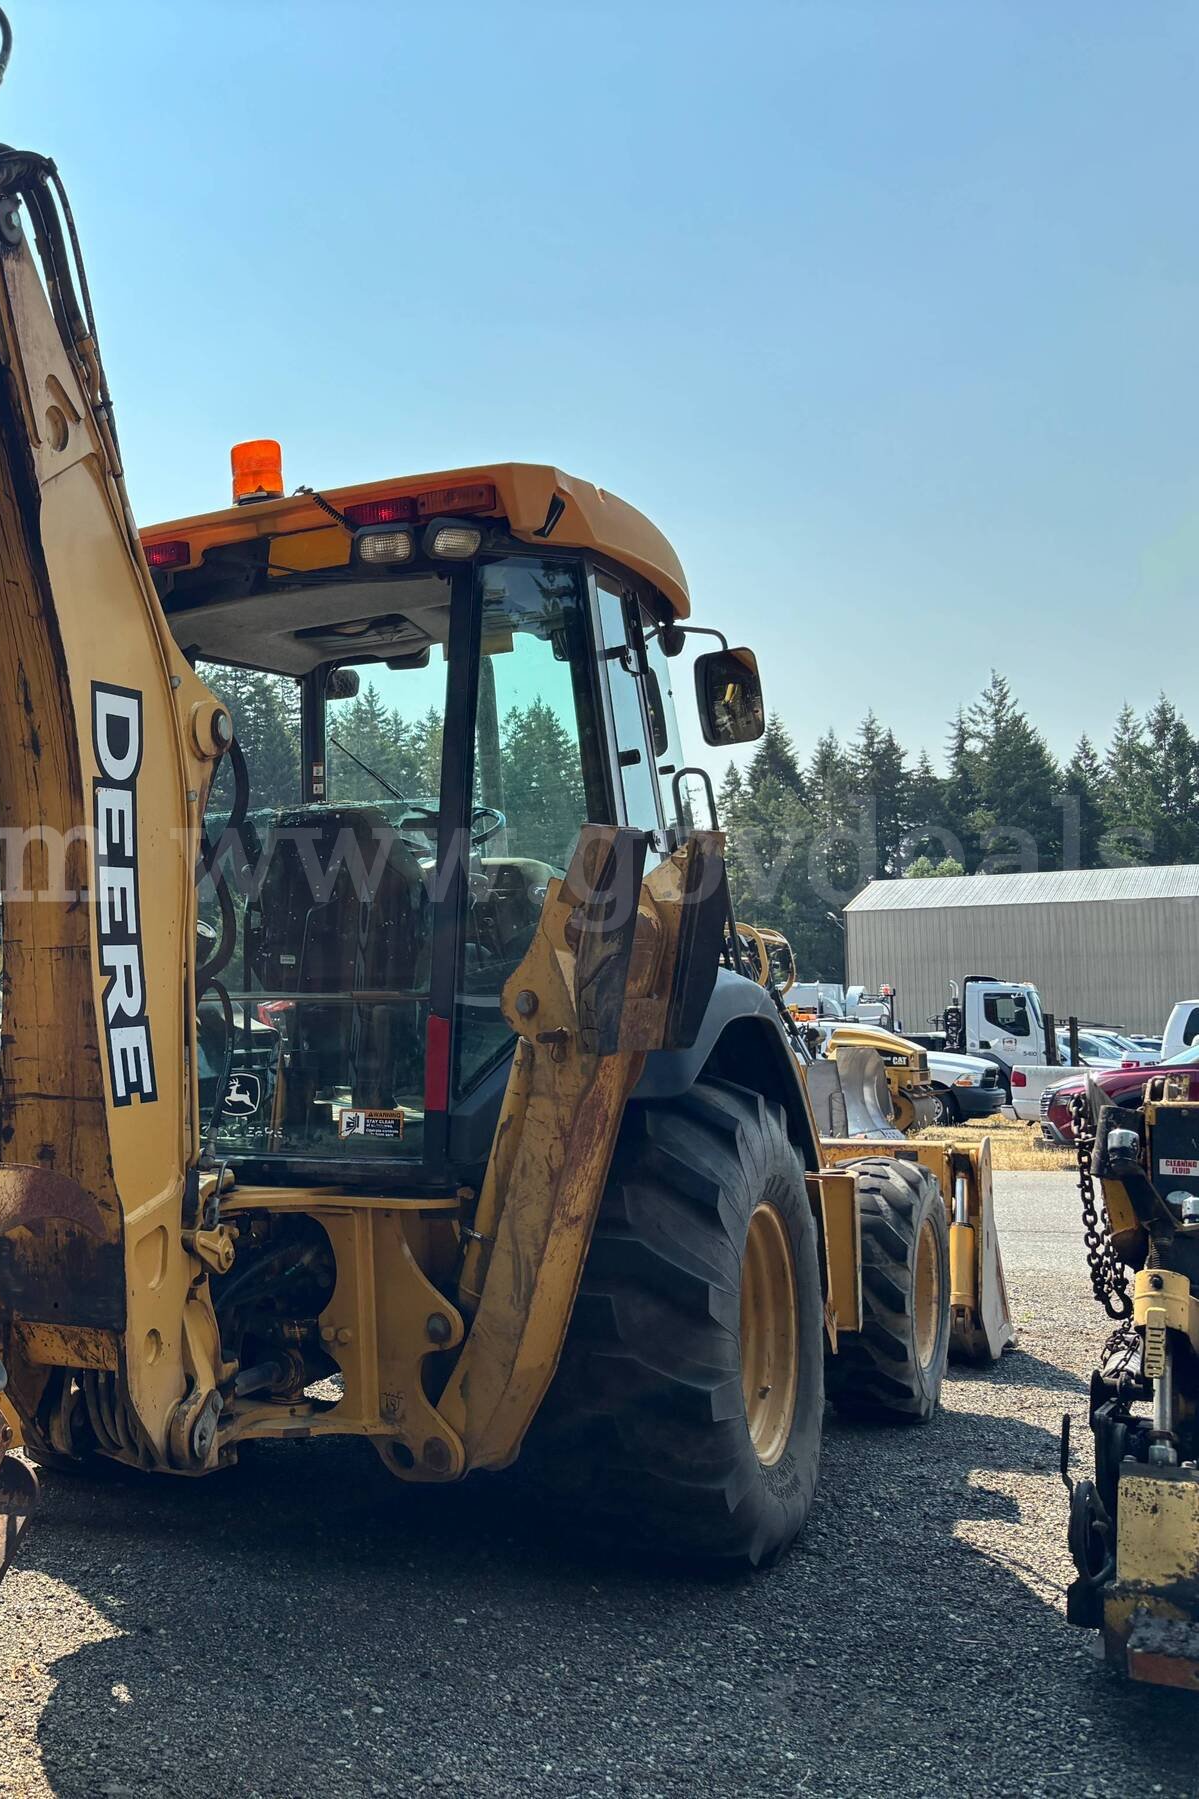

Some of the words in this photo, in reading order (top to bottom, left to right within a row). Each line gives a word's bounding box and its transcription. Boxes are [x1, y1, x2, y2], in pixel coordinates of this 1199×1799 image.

[94, 690, 153, 1098] DEERE
[892, 1056, 907, 1065] CAT
[1165, 1160, 1198, 1168] CLEANING
